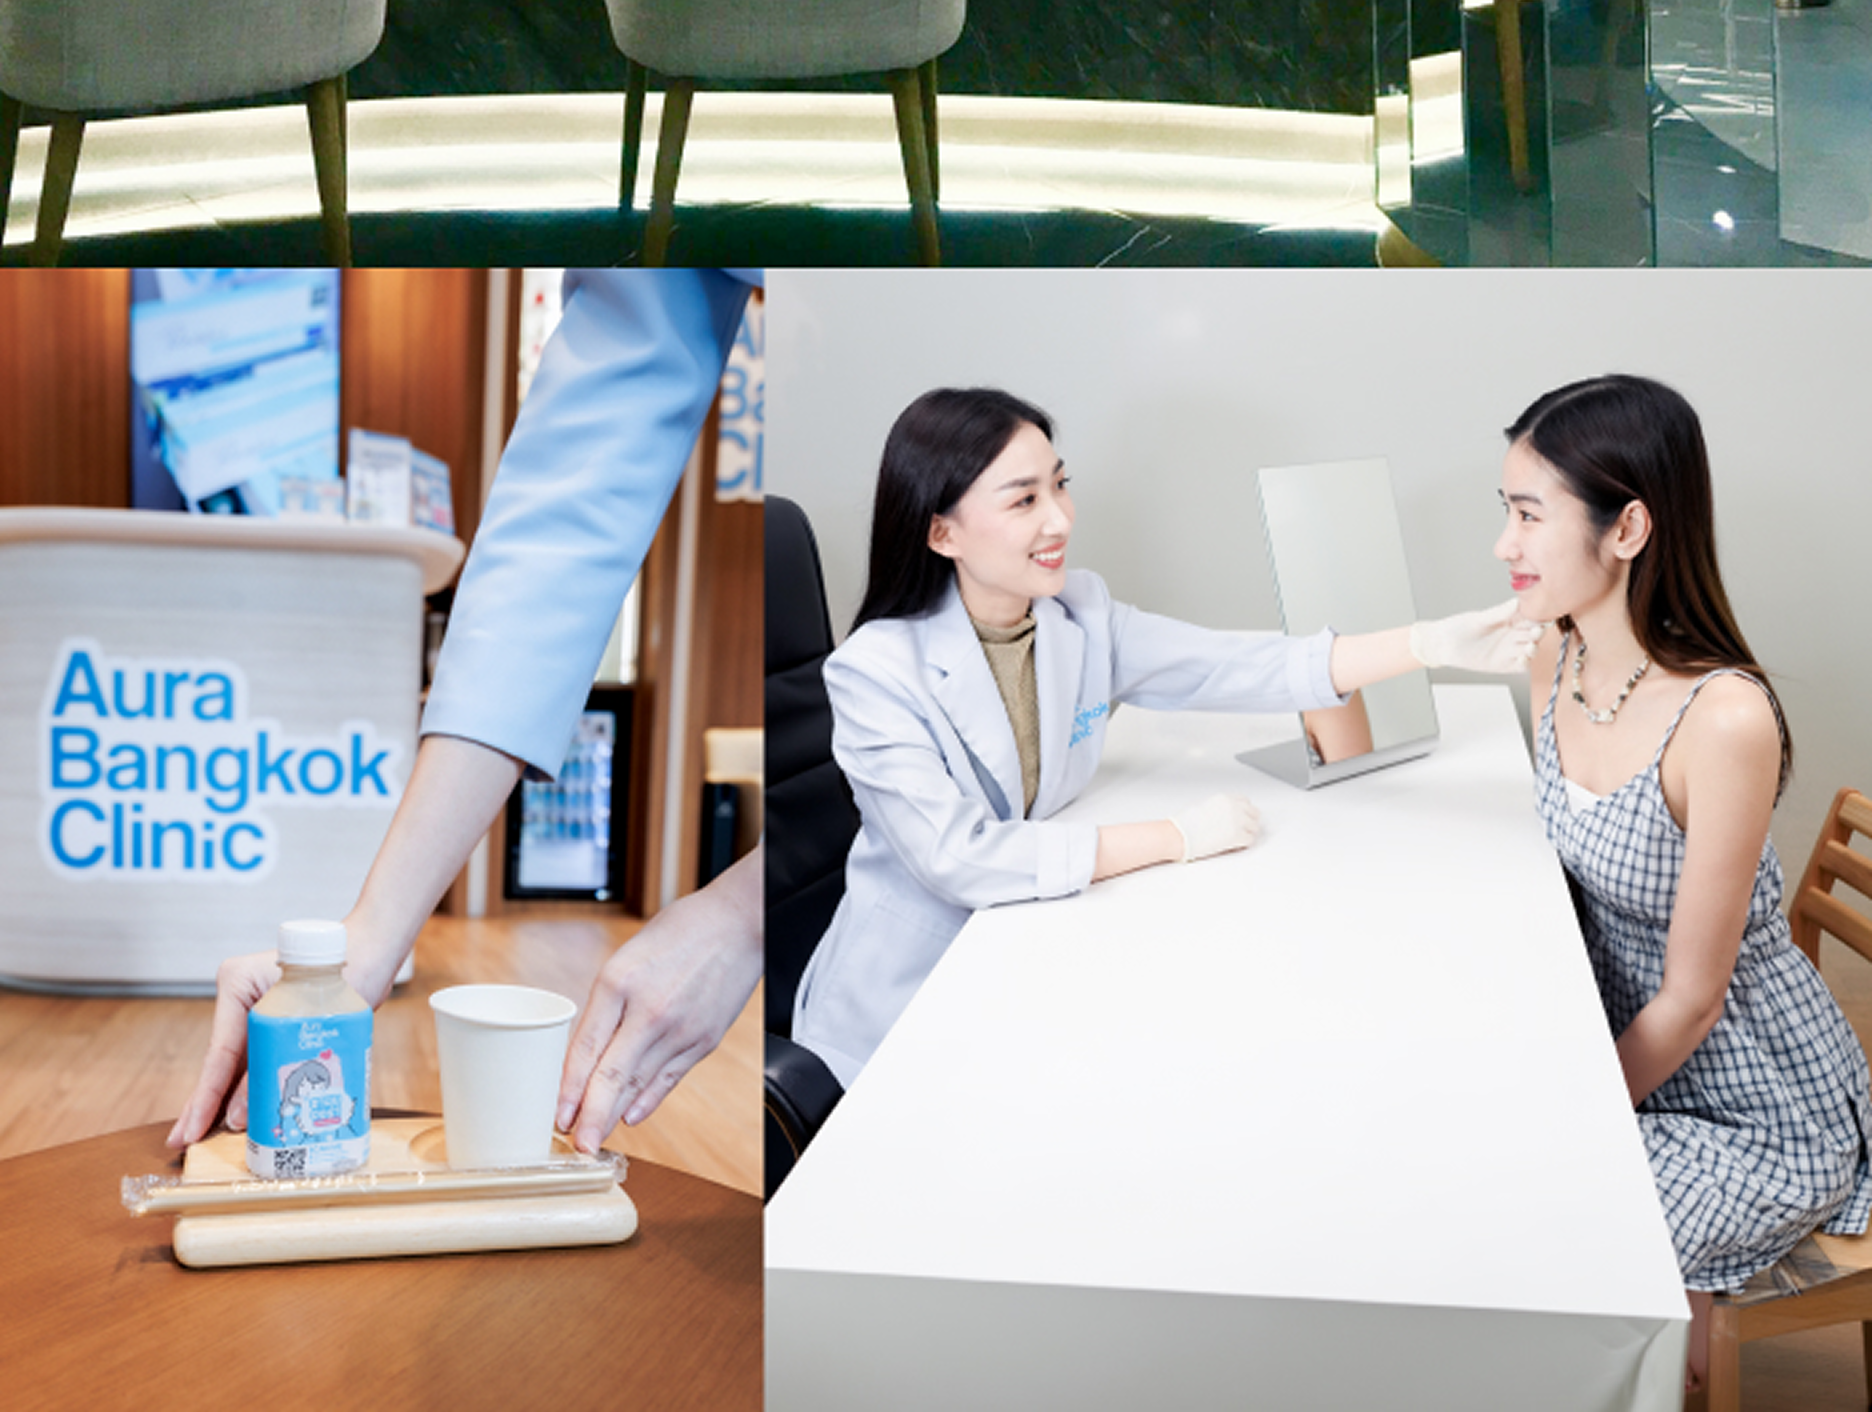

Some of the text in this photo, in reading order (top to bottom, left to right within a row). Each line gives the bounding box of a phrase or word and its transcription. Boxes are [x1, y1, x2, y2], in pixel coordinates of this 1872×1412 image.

[52, 650, 235, 721] Aura
[50, 725, 391, 815] Bangkok
[50, 798, 266, 871] Clinic
